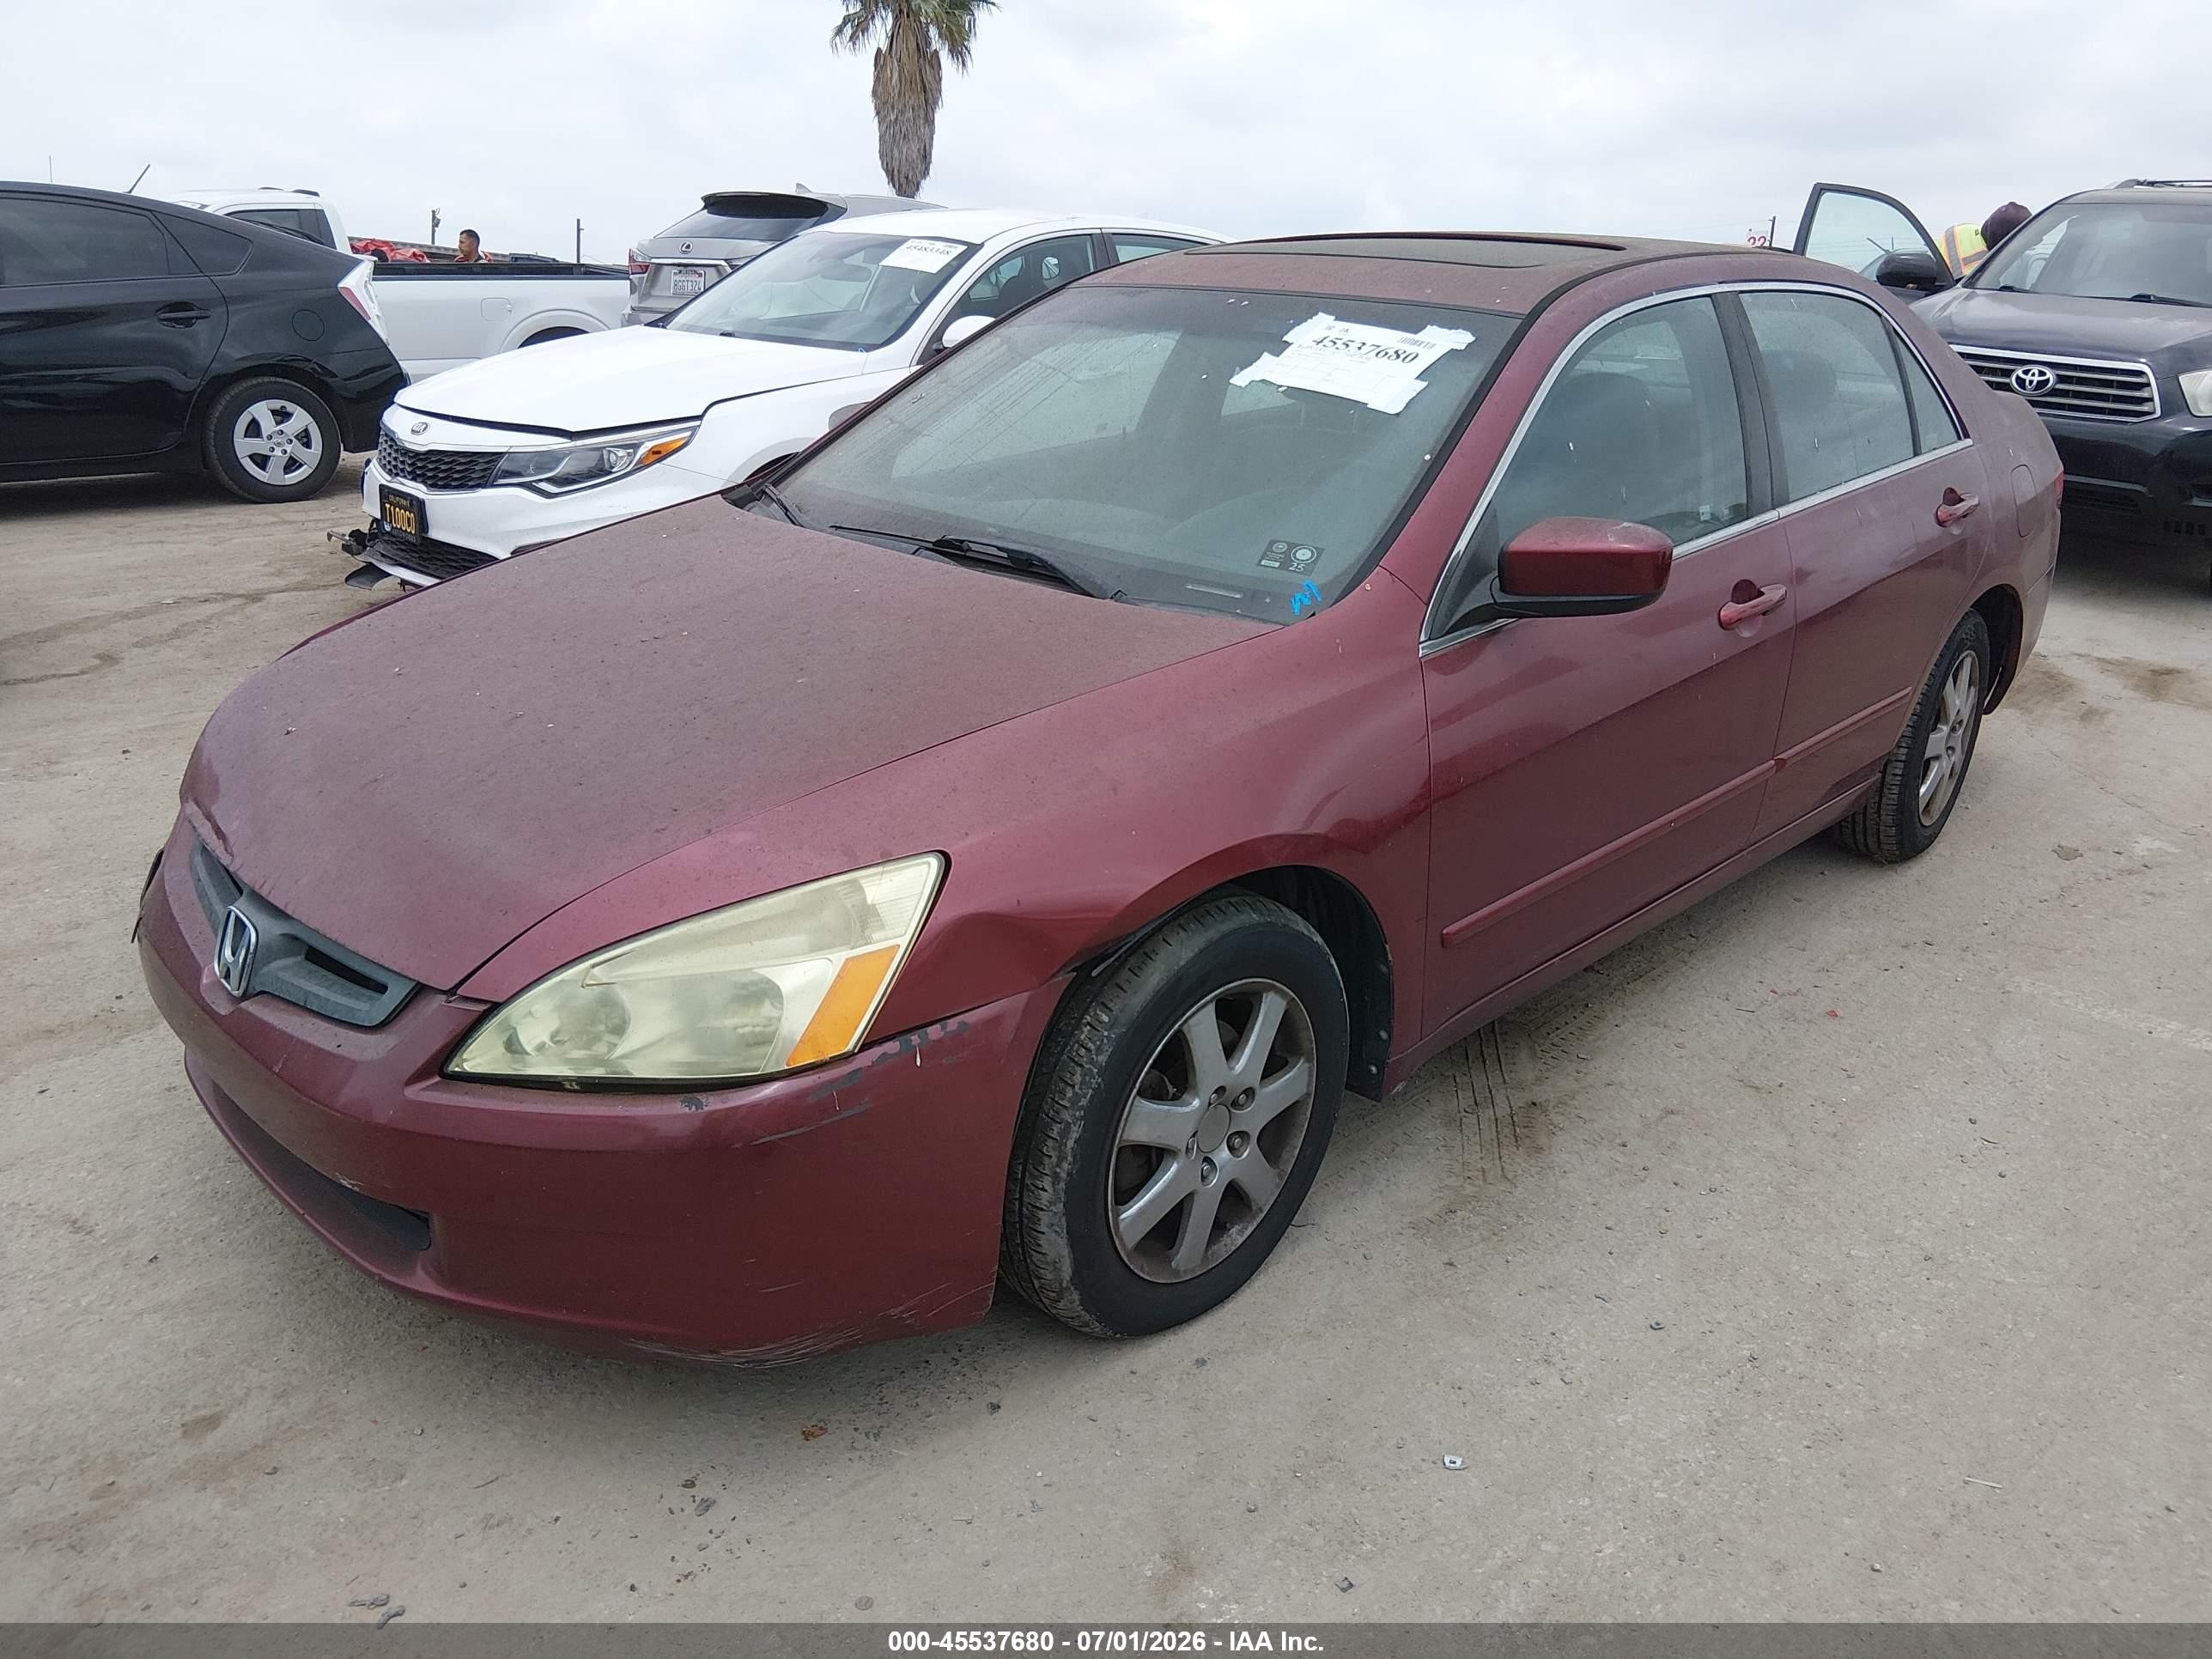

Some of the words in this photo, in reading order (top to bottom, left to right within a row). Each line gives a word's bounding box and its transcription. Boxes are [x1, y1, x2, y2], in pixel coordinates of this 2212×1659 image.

[673, 279, 702, 292] 8GGT324
[1311, 334, 1420, 365] 45537680
[1288, 562, 1306, 572] 25
